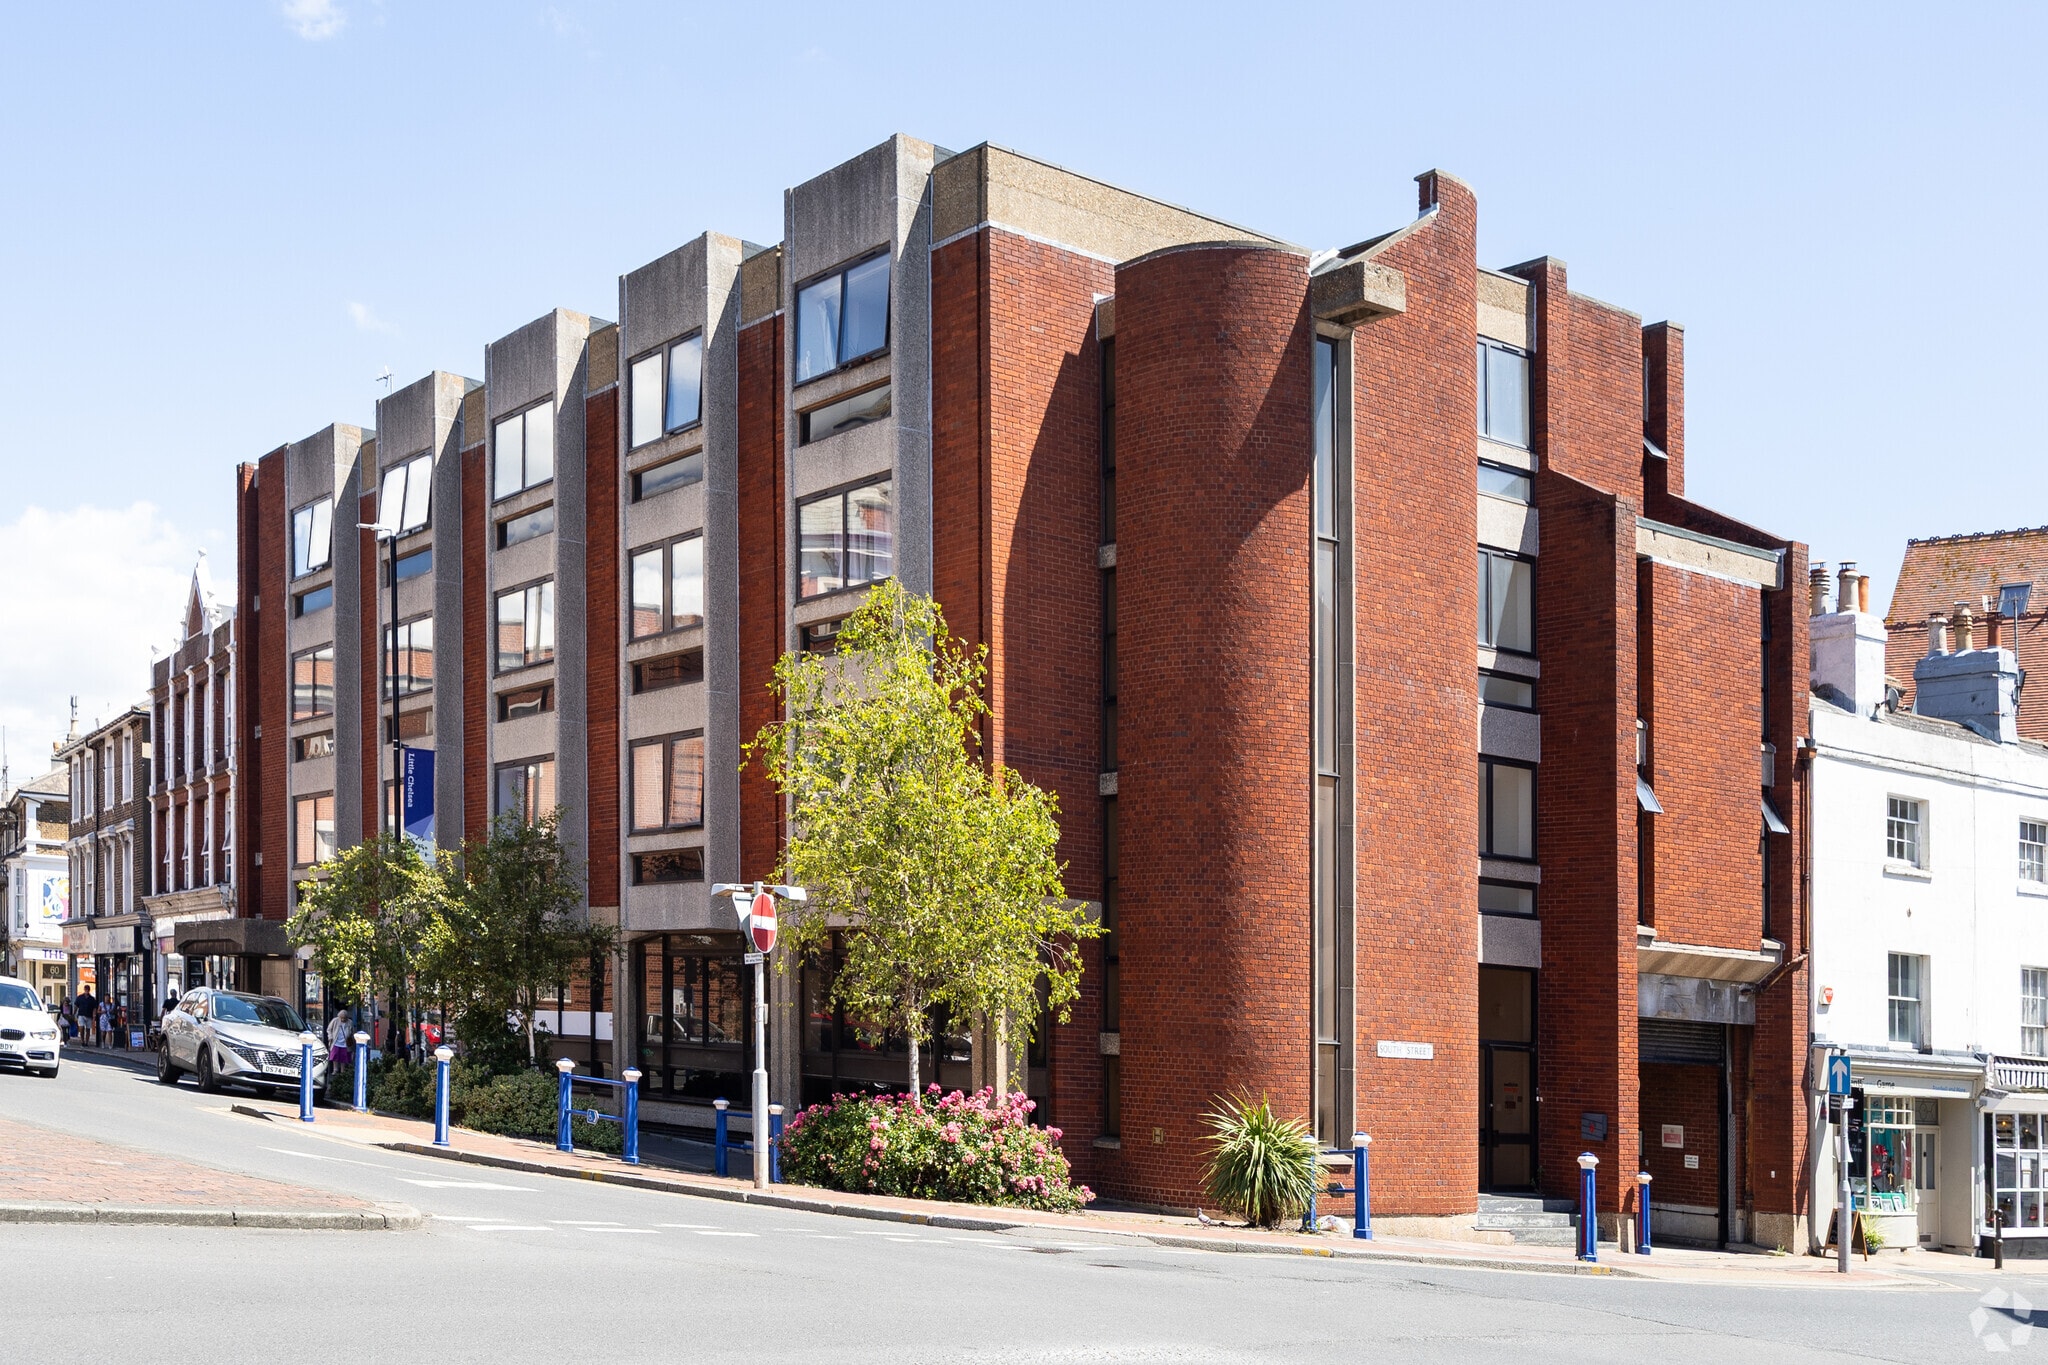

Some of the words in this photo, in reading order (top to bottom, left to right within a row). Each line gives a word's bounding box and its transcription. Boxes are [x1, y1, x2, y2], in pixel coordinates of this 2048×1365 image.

[407, 753, 415, 774] Little
[407, 776, 415, 808] Chelsea
[42, 949, 65, 960] THE
[50, 966, 60, 975] 60
[1379, 1044, 1402, 1055] SOUTH
[1407, 1046, 1431, 1056] STREET
